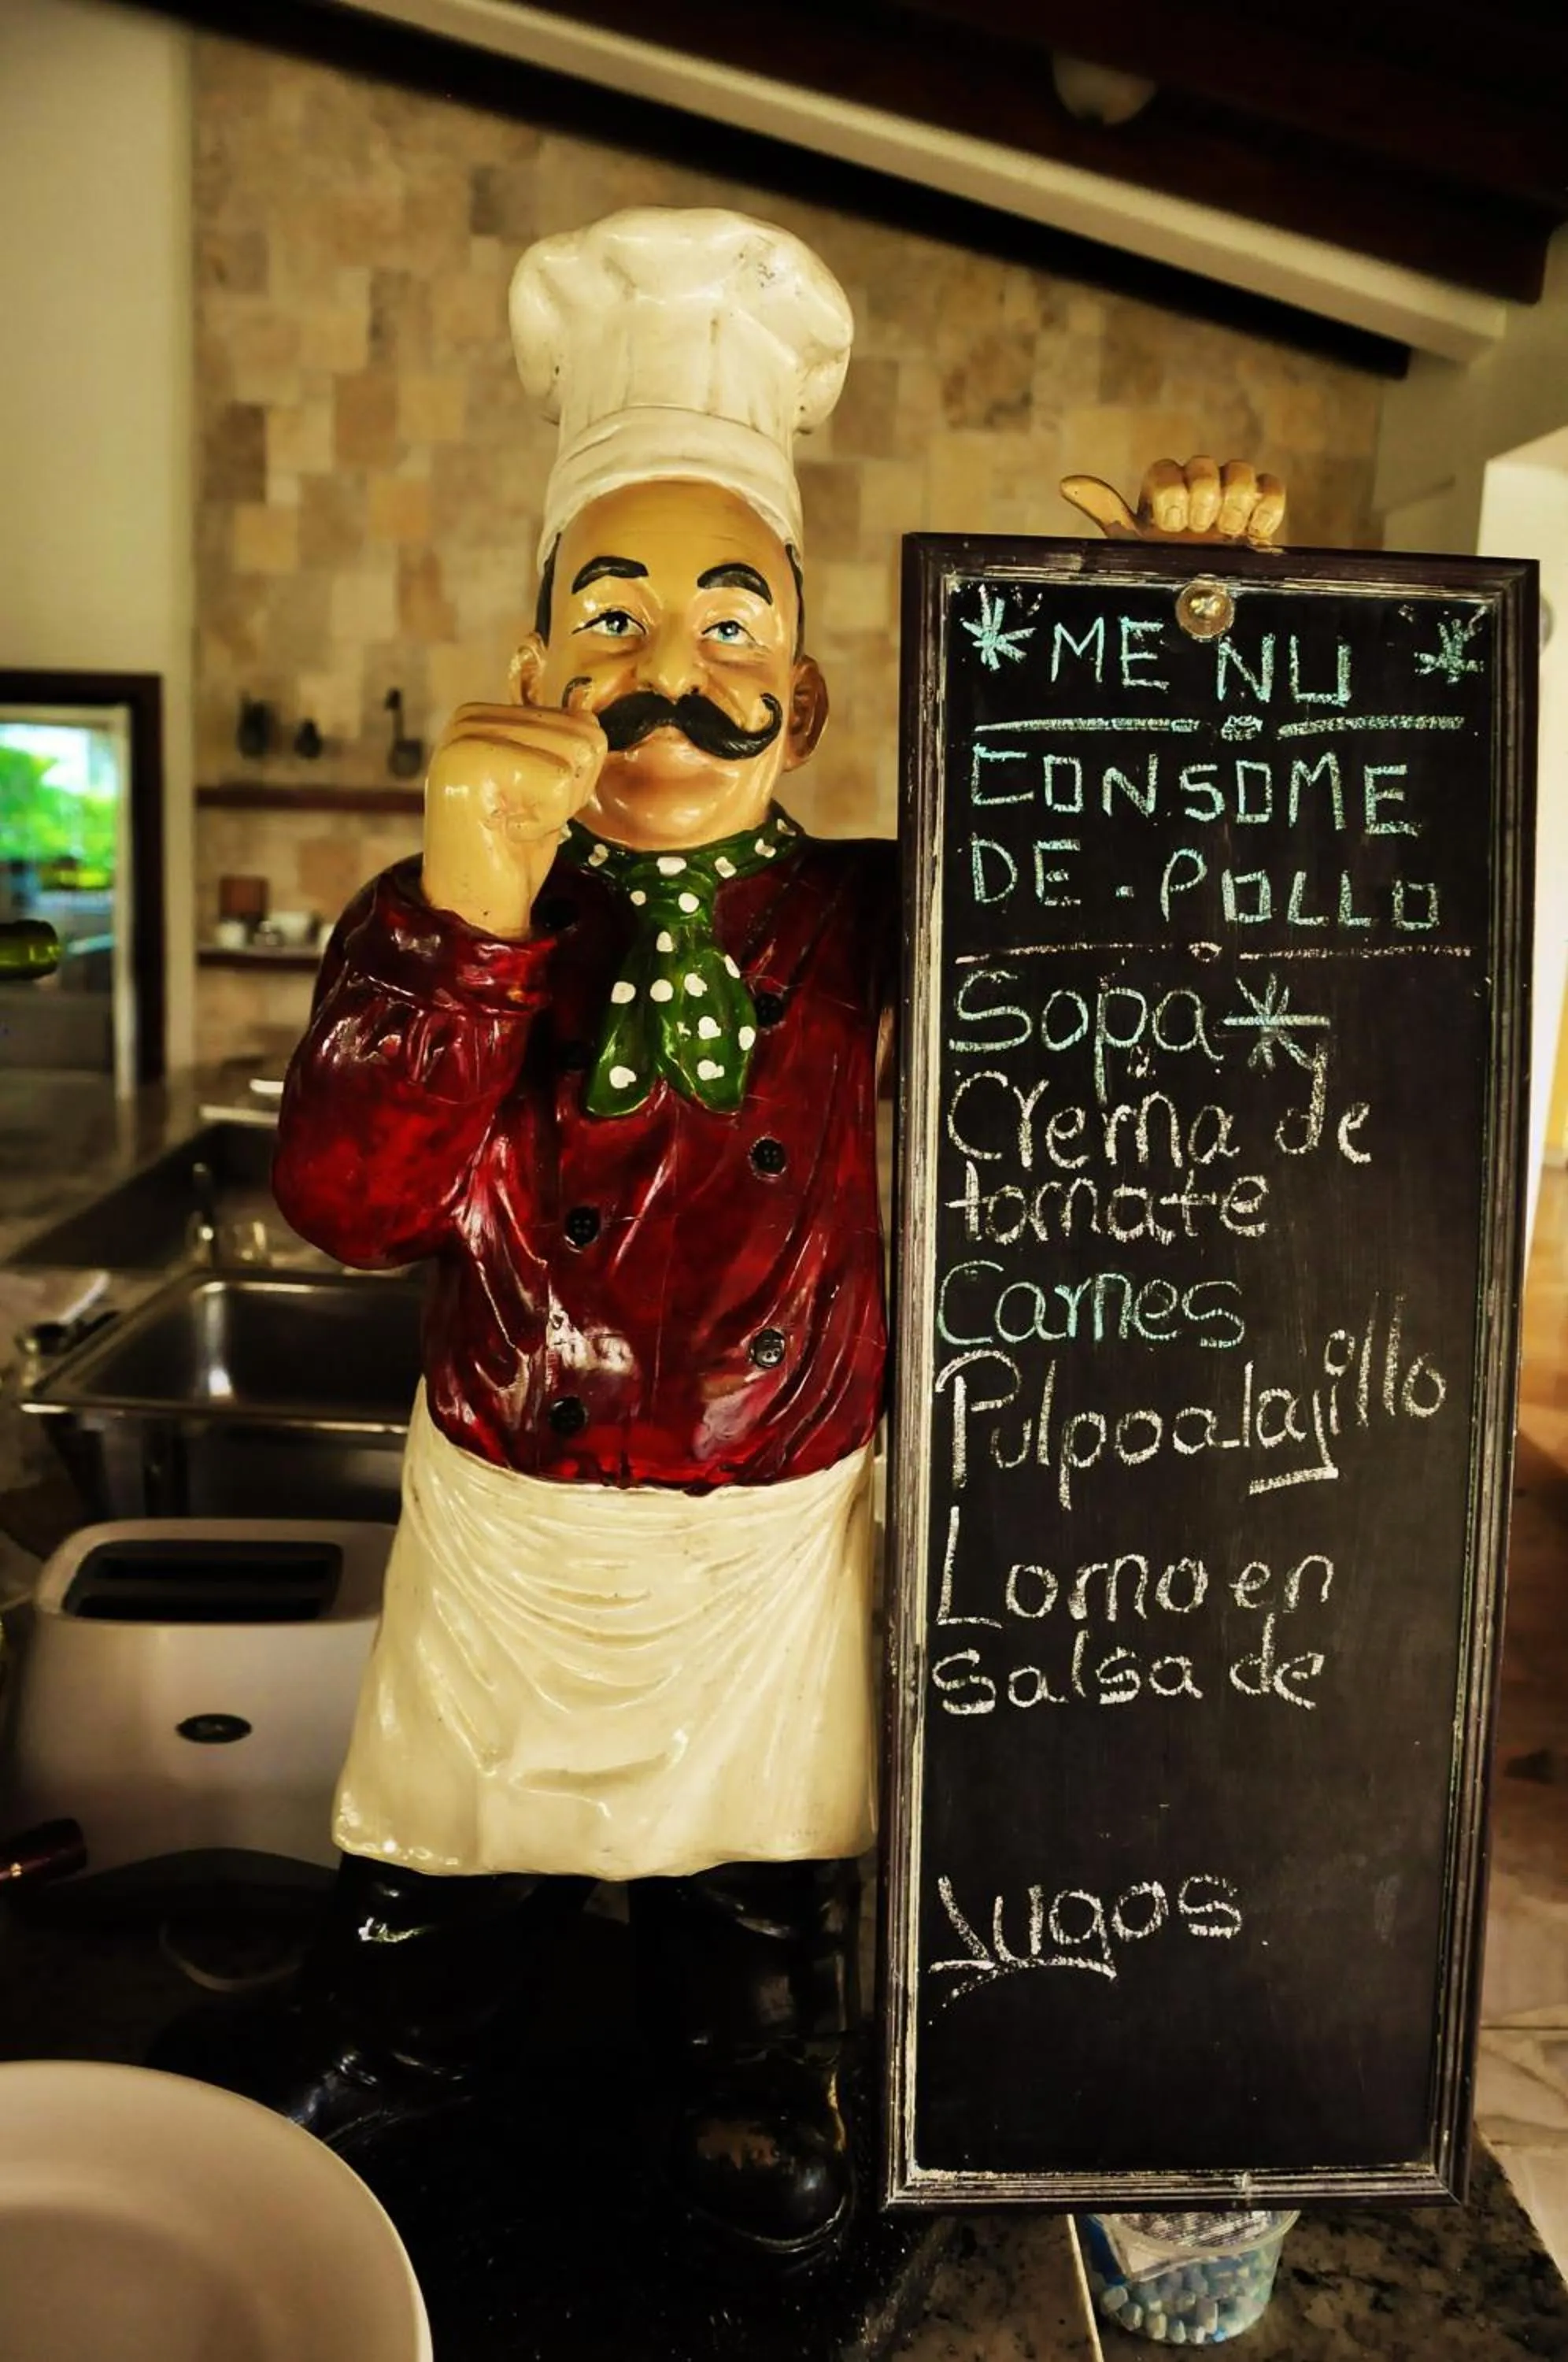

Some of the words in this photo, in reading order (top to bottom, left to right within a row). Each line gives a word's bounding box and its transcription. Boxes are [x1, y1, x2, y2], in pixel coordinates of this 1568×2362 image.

[971, 742, 1418, 836] CONSOME
[971, 833, 1082, 906] DE
[1159, 848, 1440, 931] POLLO
[949, 969, 1225, 1103] Sopa
[947, 1070, 1241, 1169] Crema
[1274, 1041, 1372, 1164] de
[945, 1160, 1270, 1246] tomate
[937, 1261, 1245, 1349] Carnes
[937, 1505, 1209, 1628] Lomo
[1229, 1554, 1334, 1613] en
[1228, 1612, 1325, 1710] de
